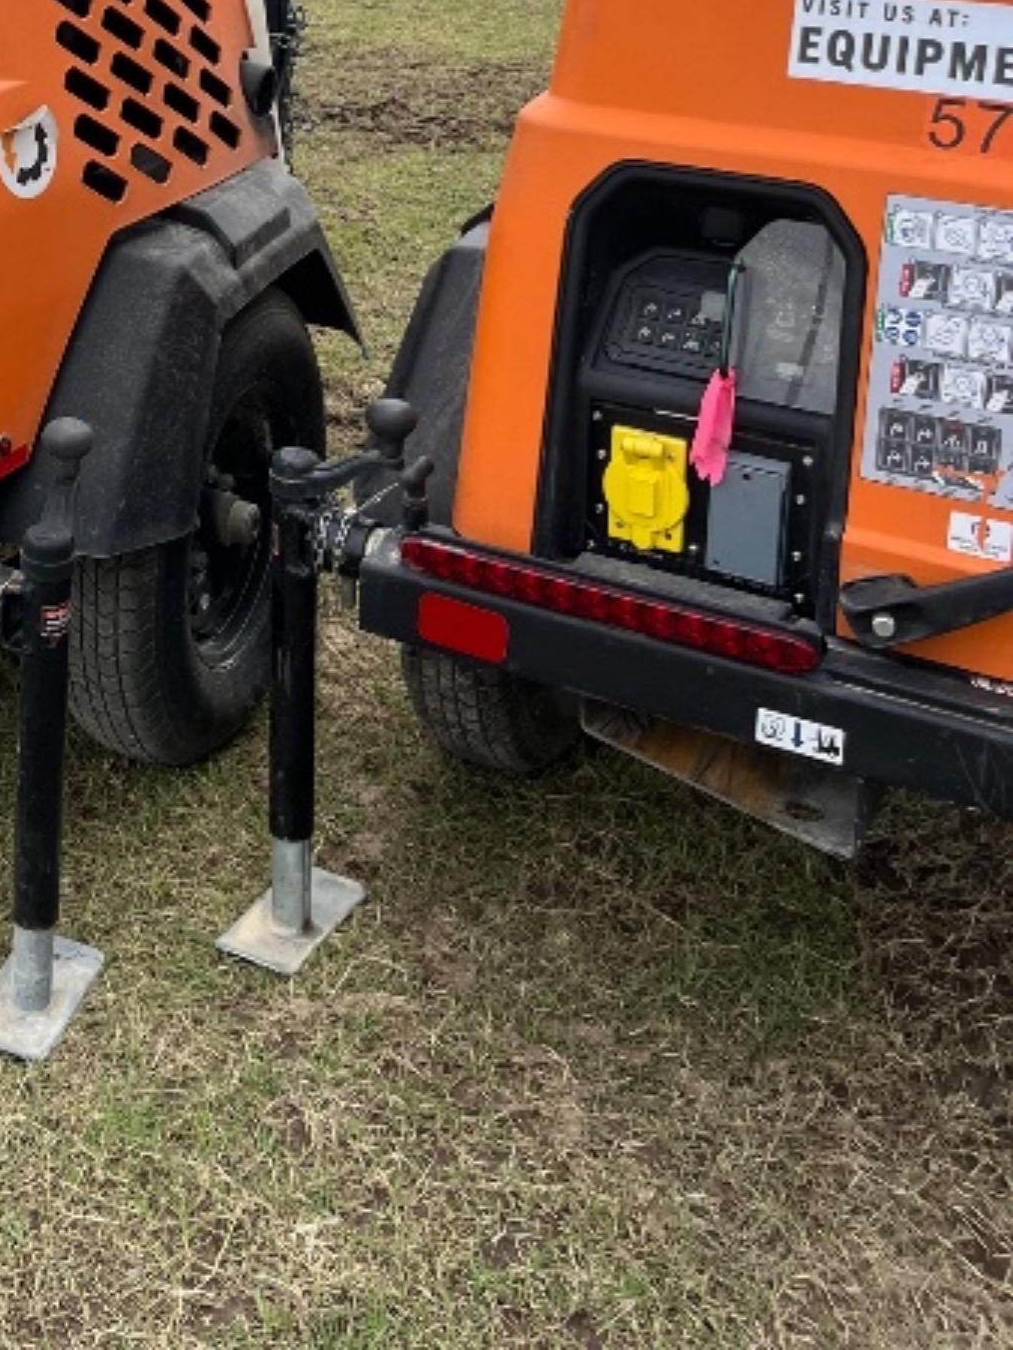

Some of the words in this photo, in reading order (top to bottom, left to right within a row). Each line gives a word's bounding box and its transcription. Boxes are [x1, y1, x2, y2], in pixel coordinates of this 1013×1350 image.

[883, 2, 916, 25] US
[928, 8, 971, 28] AT:
[928, 97, 1013, 154] 57
